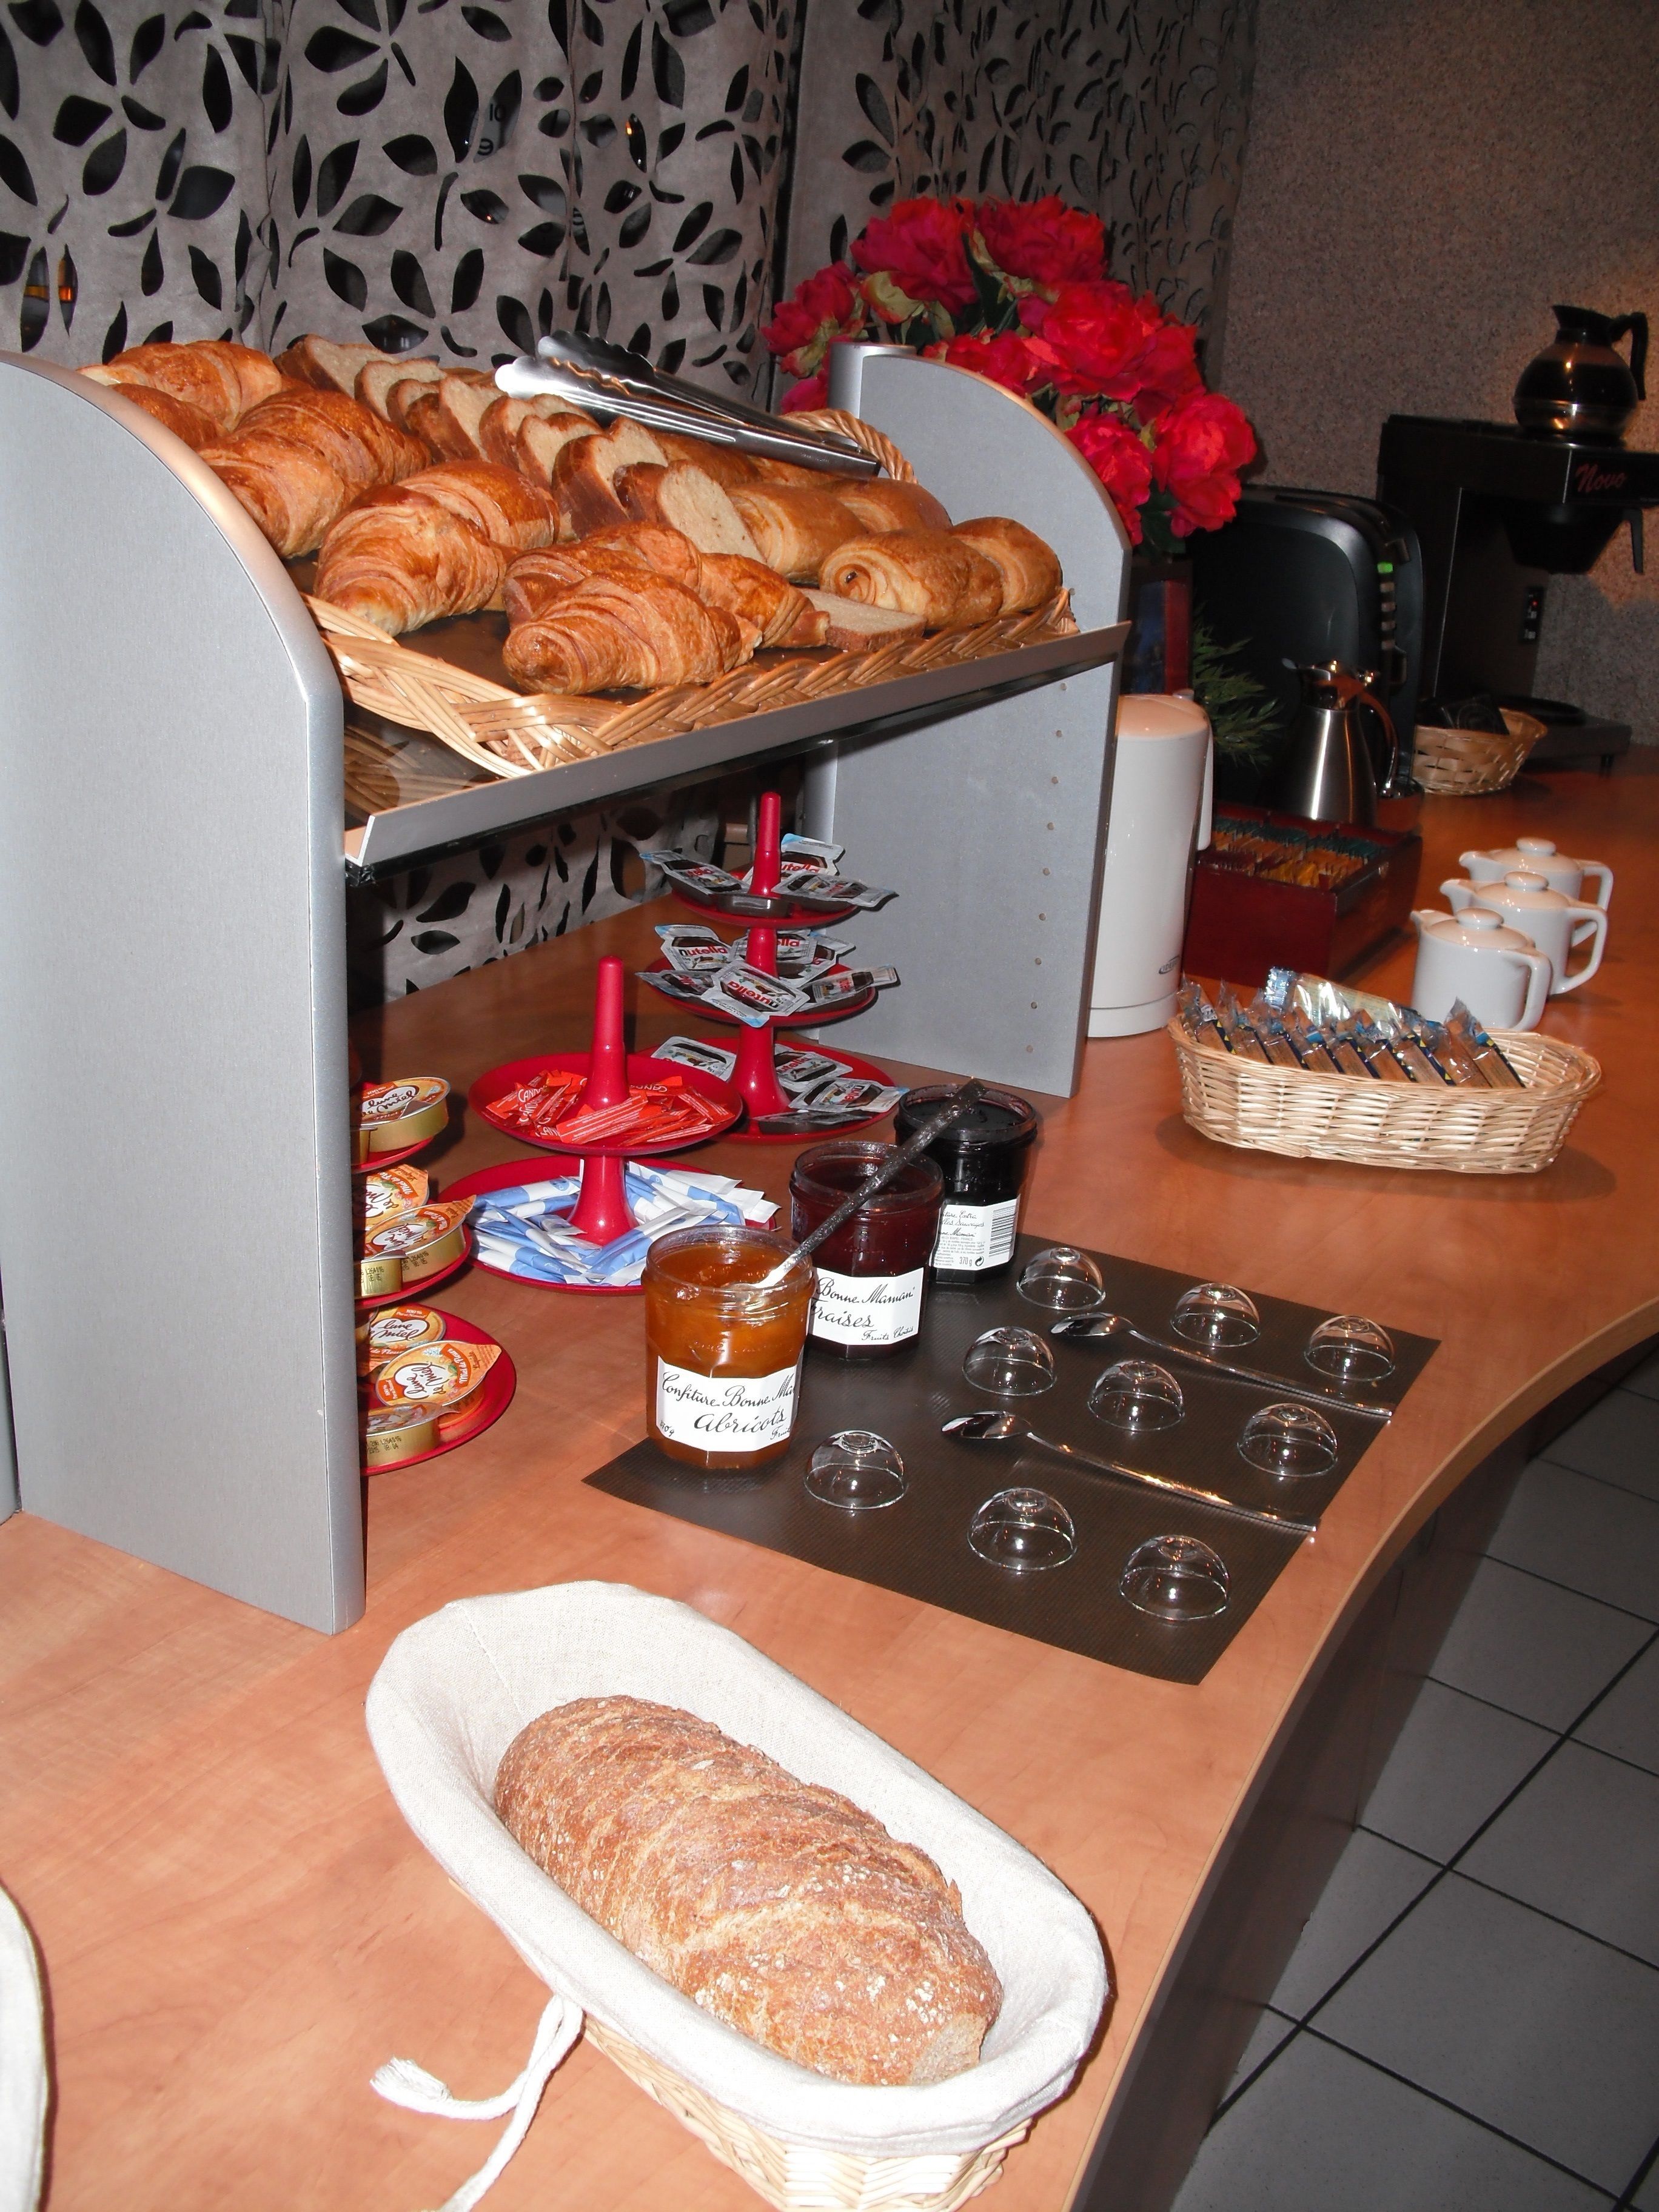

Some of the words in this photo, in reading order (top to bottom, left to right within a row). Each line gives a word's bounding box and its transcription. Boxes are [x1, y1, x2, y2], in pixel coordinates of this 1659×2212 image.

[679, 946, 728, 957] nutella
[728, 980, 780, 1008] nutella
[959, 1256, 968, 1265] 370
[816, 1276, 859, 1304] Bonne
[861, 1283, 913, 1304] Maman
[862, 1329, 890, 1341] Fruits
[662, 1372, 720, 1407] Confiture
[722, 1385, 771, 1407] Bonne
[770, 1425, 791, 1441] Fruit
